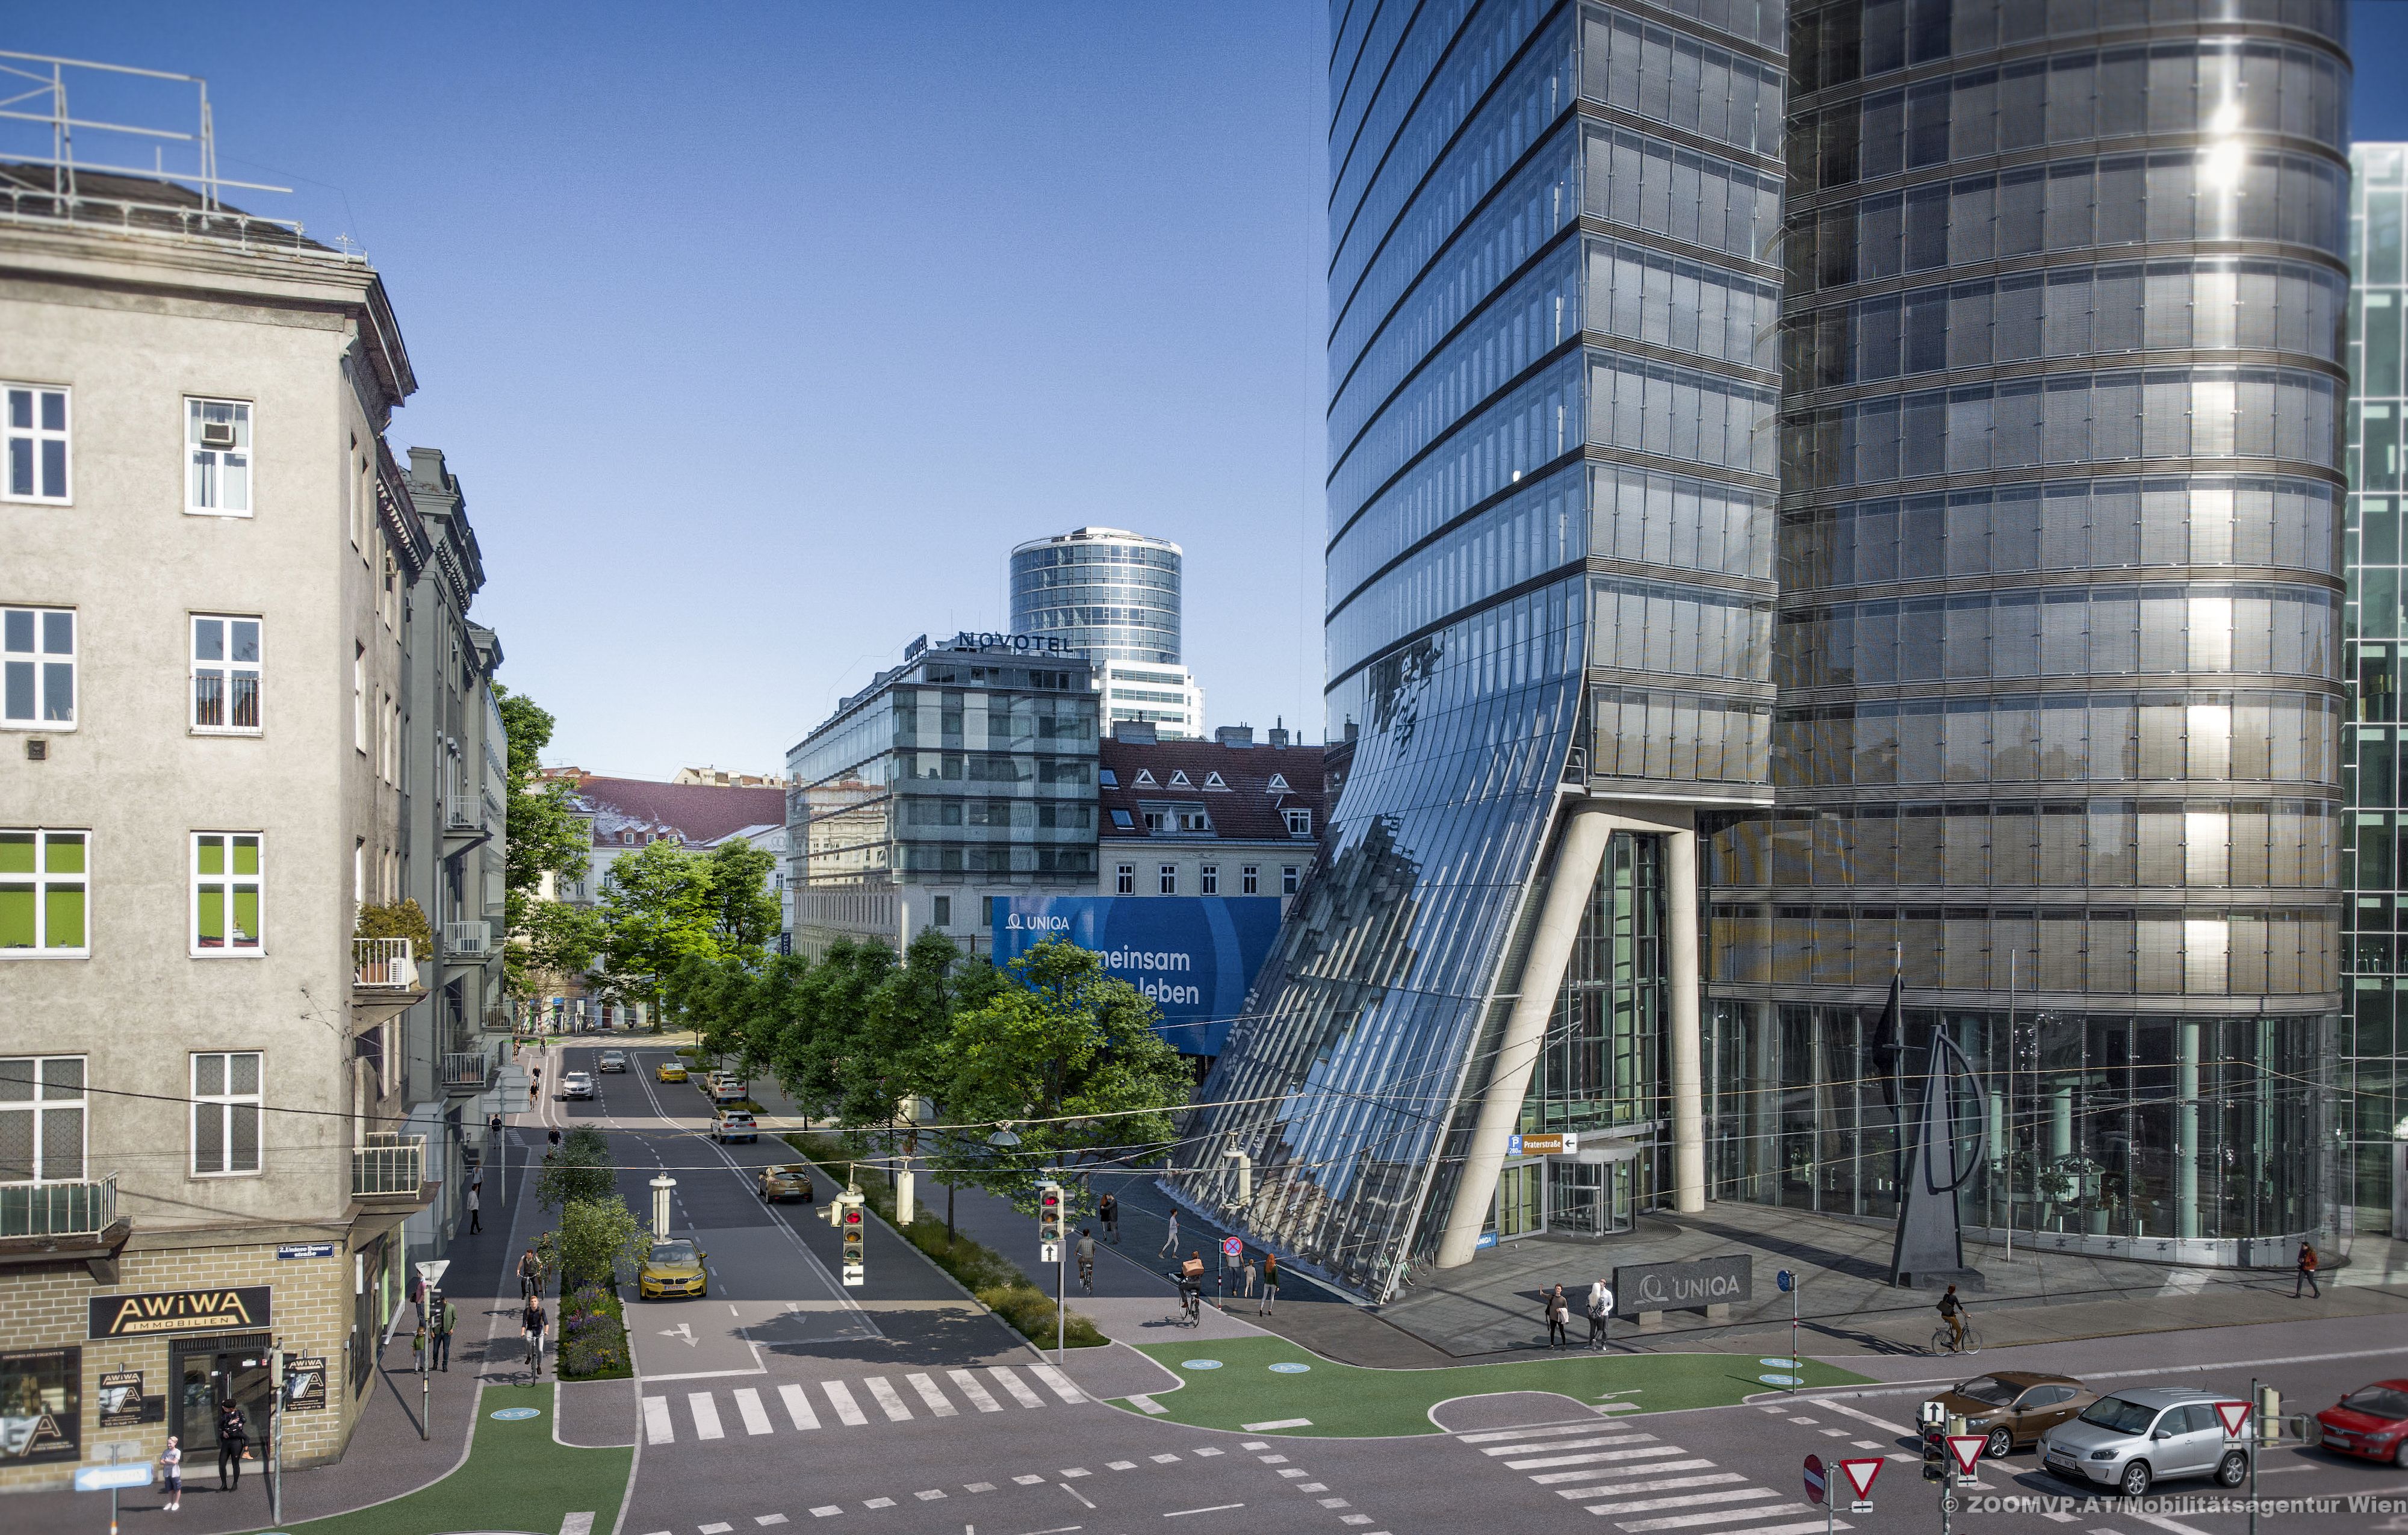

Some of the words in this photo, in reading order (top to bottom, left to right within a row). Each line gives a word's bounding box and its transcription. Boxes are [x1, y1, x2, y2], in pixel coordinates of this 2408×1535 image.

[904, 634, 926, 662] NOVOTEL
[959, 631, 1073, 653] NOVOTEL
[1027, 916, 1070, 930] UNIQA
[1140, 977, 1199, 1005] leben
[1675, 1275, 1740, 1300] UNIQA
[109, 1292, 252, 1334] AWiWA
[134, 1316, 229, 1330] IMMOBILIEN
[102, 1373, 141, 1386] AWiWA
